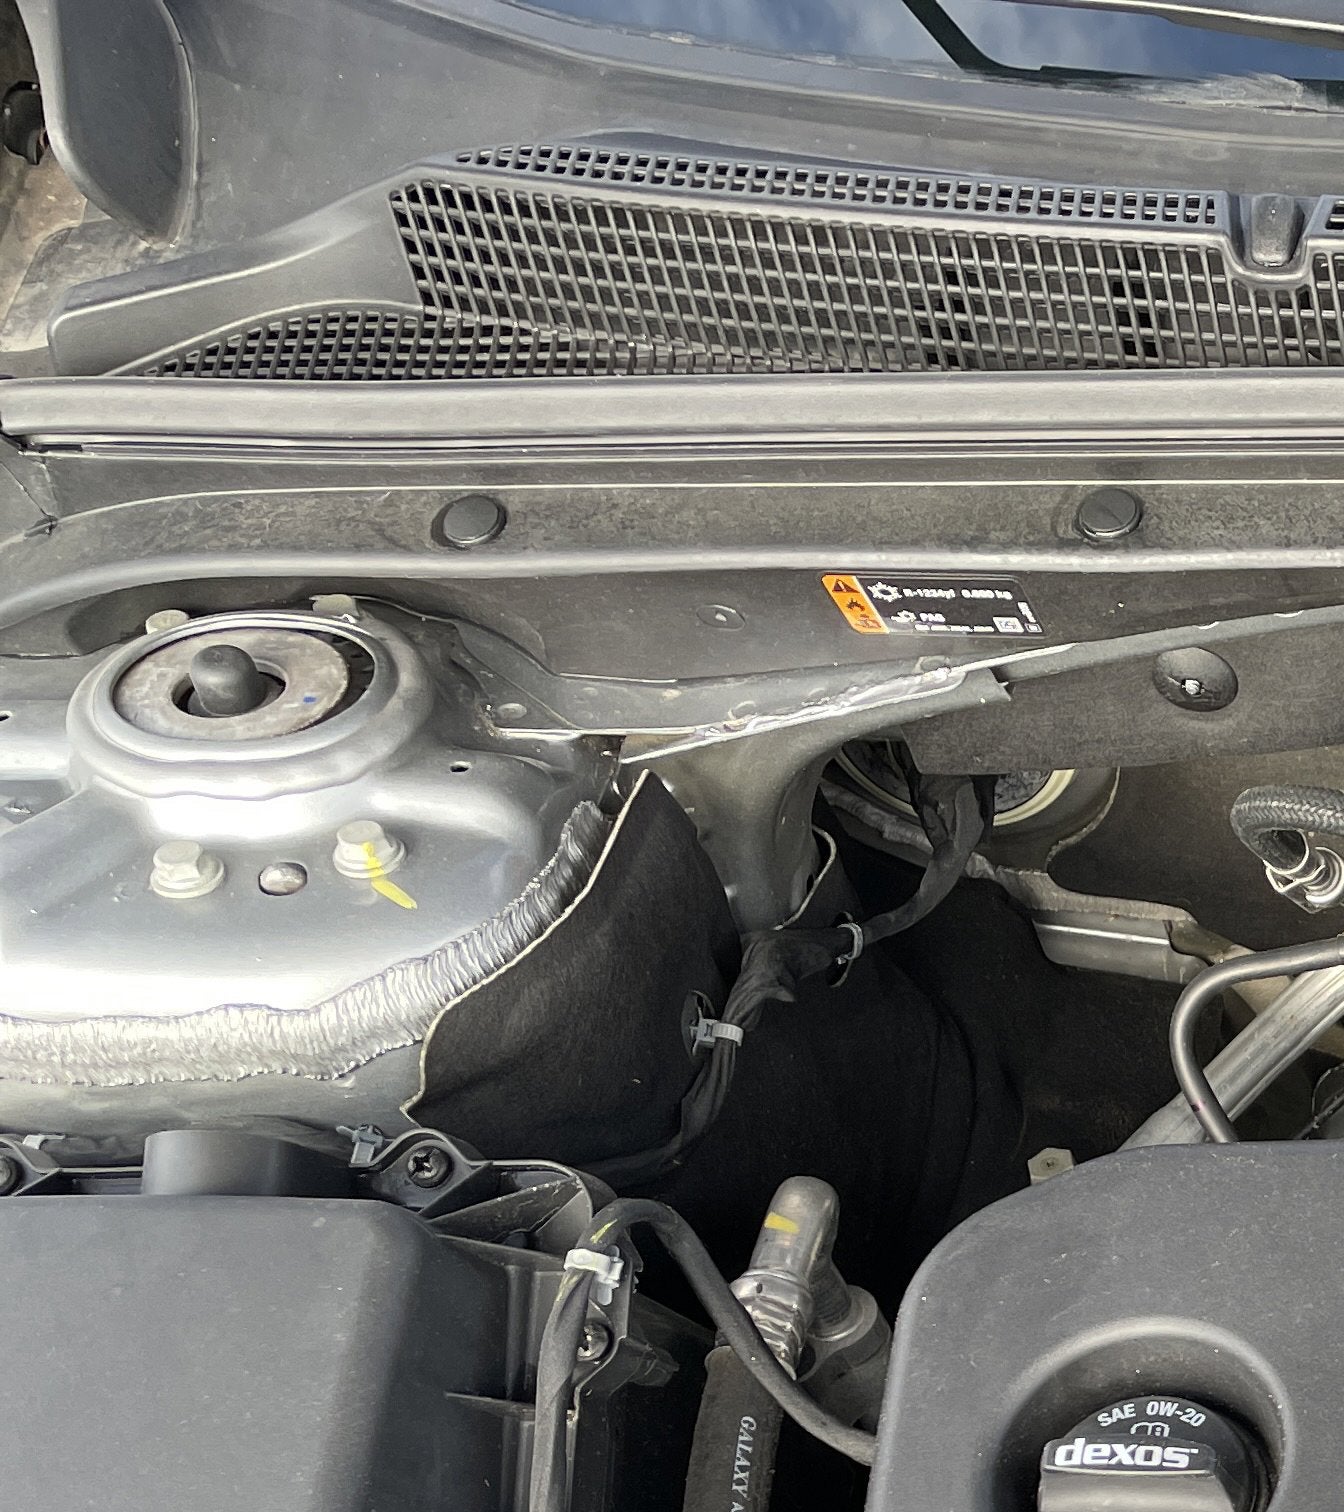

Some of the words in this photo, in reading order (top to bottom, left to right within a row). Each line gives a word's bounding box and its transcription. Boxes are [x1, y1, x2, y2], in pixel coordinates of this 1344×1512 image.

[1097, 1403, 1136, 1427] SAE
[1146, 1401, 1206, 1427] 0W-20
[731, 1414, 757, 1499] GALAXY
[1055, 1438, 1190, 1468] dexos
